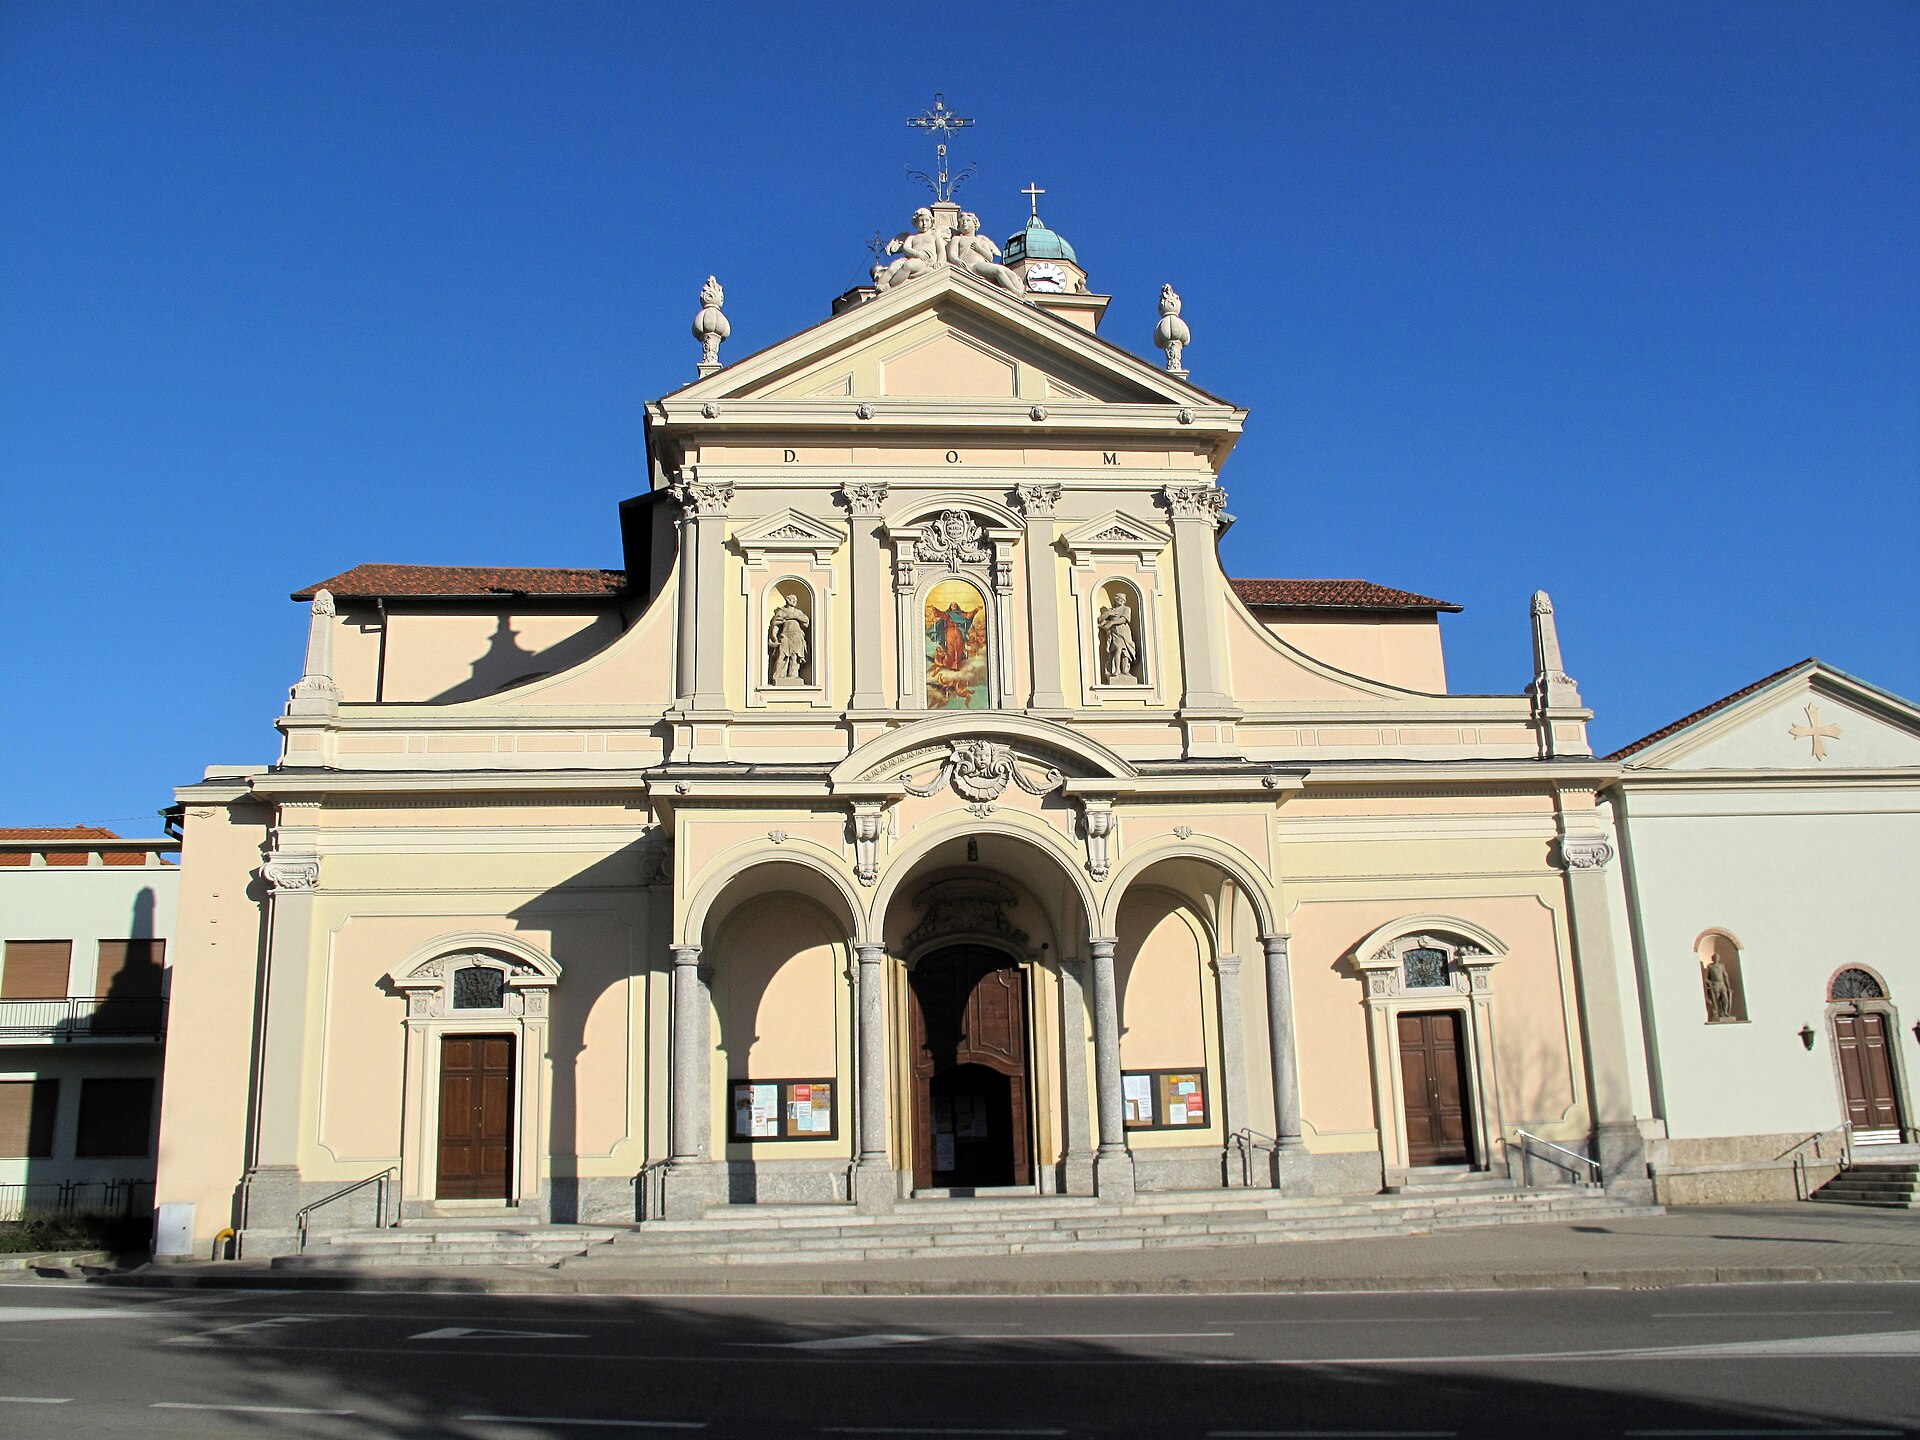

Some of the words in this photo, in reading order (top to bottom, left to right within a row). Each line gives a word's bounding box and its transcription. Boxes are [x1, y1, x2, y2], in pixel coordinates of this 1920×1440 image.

[783, 449, 799, 462] D.
[945, 450, 962, 463] O.
[1102, 452, 1122, 465] M.
